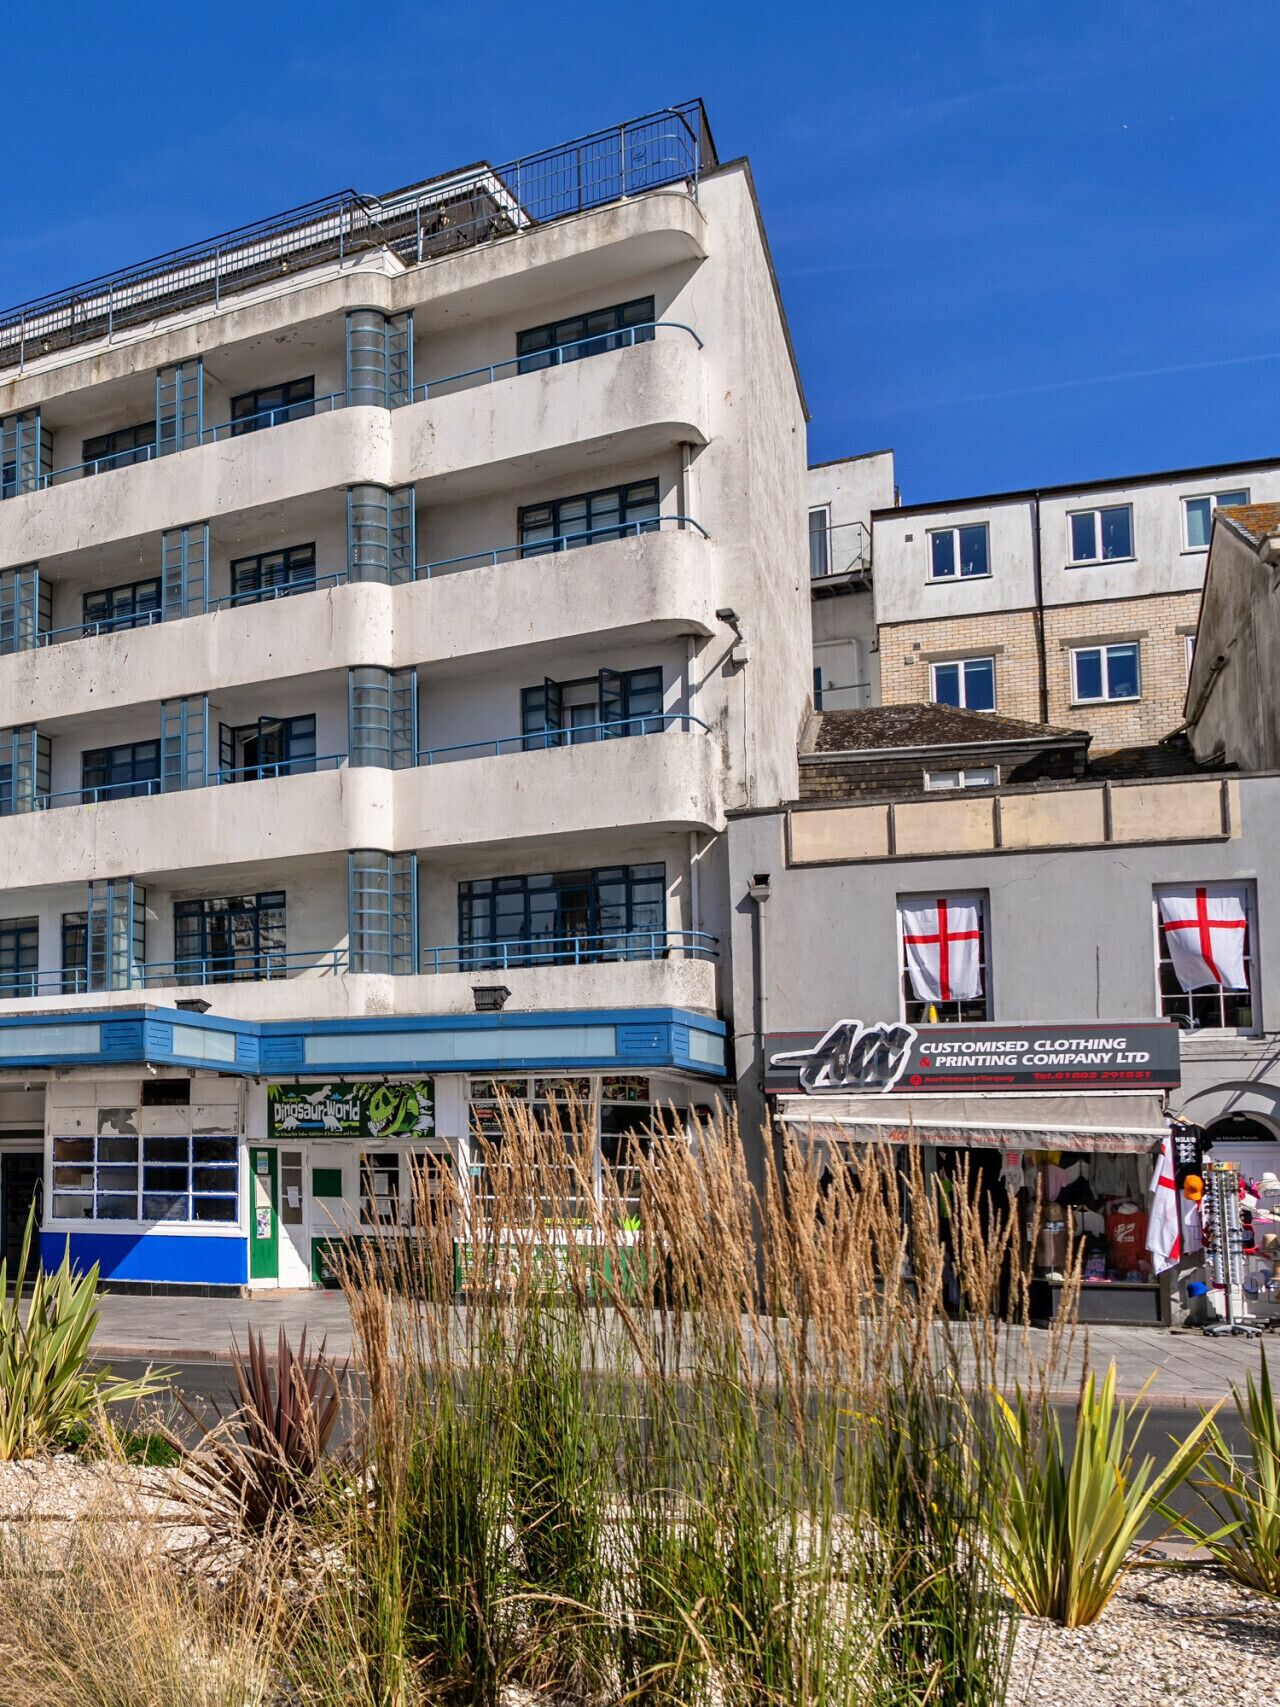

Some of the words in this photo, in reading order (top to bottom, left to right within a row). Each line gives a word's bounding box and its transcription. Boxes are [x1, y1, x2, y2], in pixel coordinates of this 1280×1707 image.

[919, 1040, 1029, 1054] CUSTOMISED
[1033, 1038, 1127, 1051] CLOTHING
[918, 1056, 931, 1068] &
[935, 1055, 1018, 1067] PRINTING
[1022, 1053, 1112, 1066] COMPANY
[1116, 1052, 1150, 1063] LTD
[274, 1102, 324, 1122] Dinosaur
[325, 1100, 360, 1120] World
